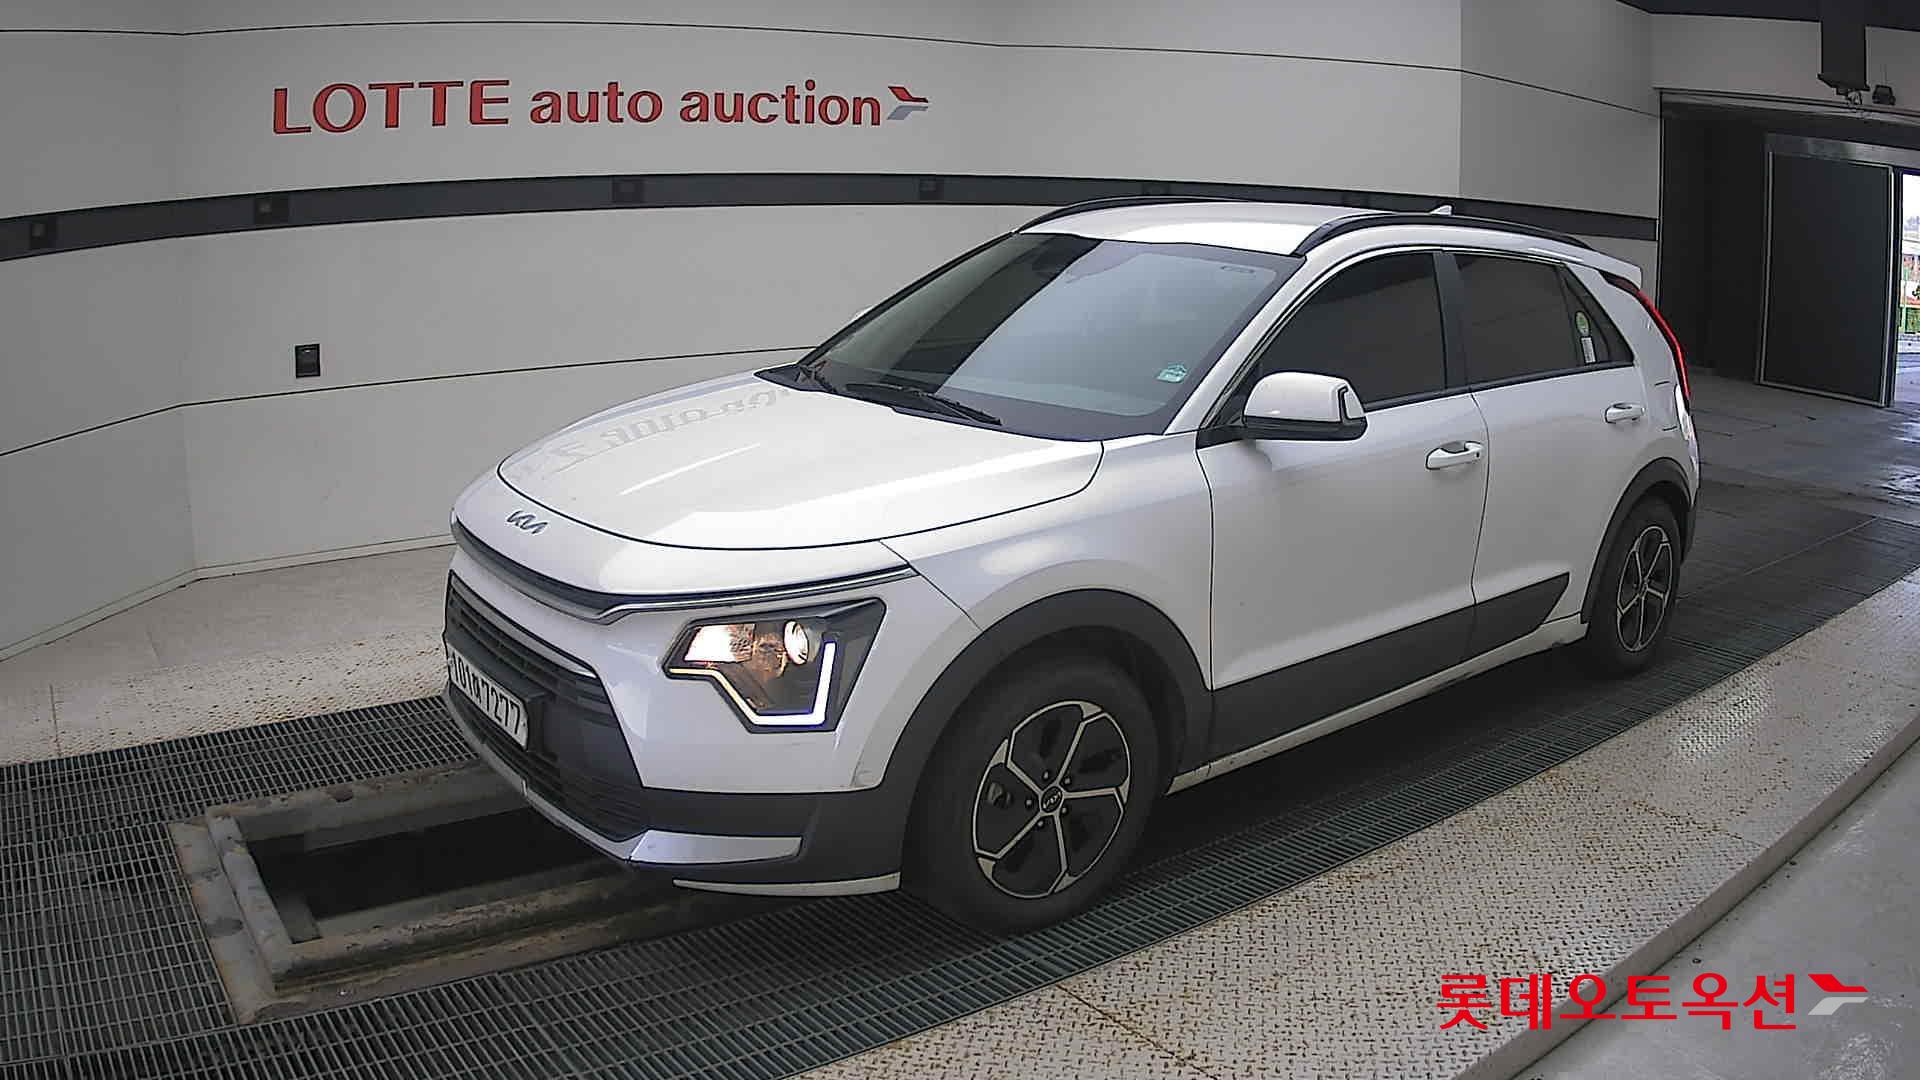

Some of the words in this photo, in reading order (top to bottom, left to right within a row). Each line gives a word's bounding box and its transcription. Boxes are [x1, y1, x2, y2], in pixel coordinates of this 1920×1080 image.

[273, 79, 508, 135] LOTTE
[530, 82, 663, 125] auto
[679, 79, 882, 127] auction
